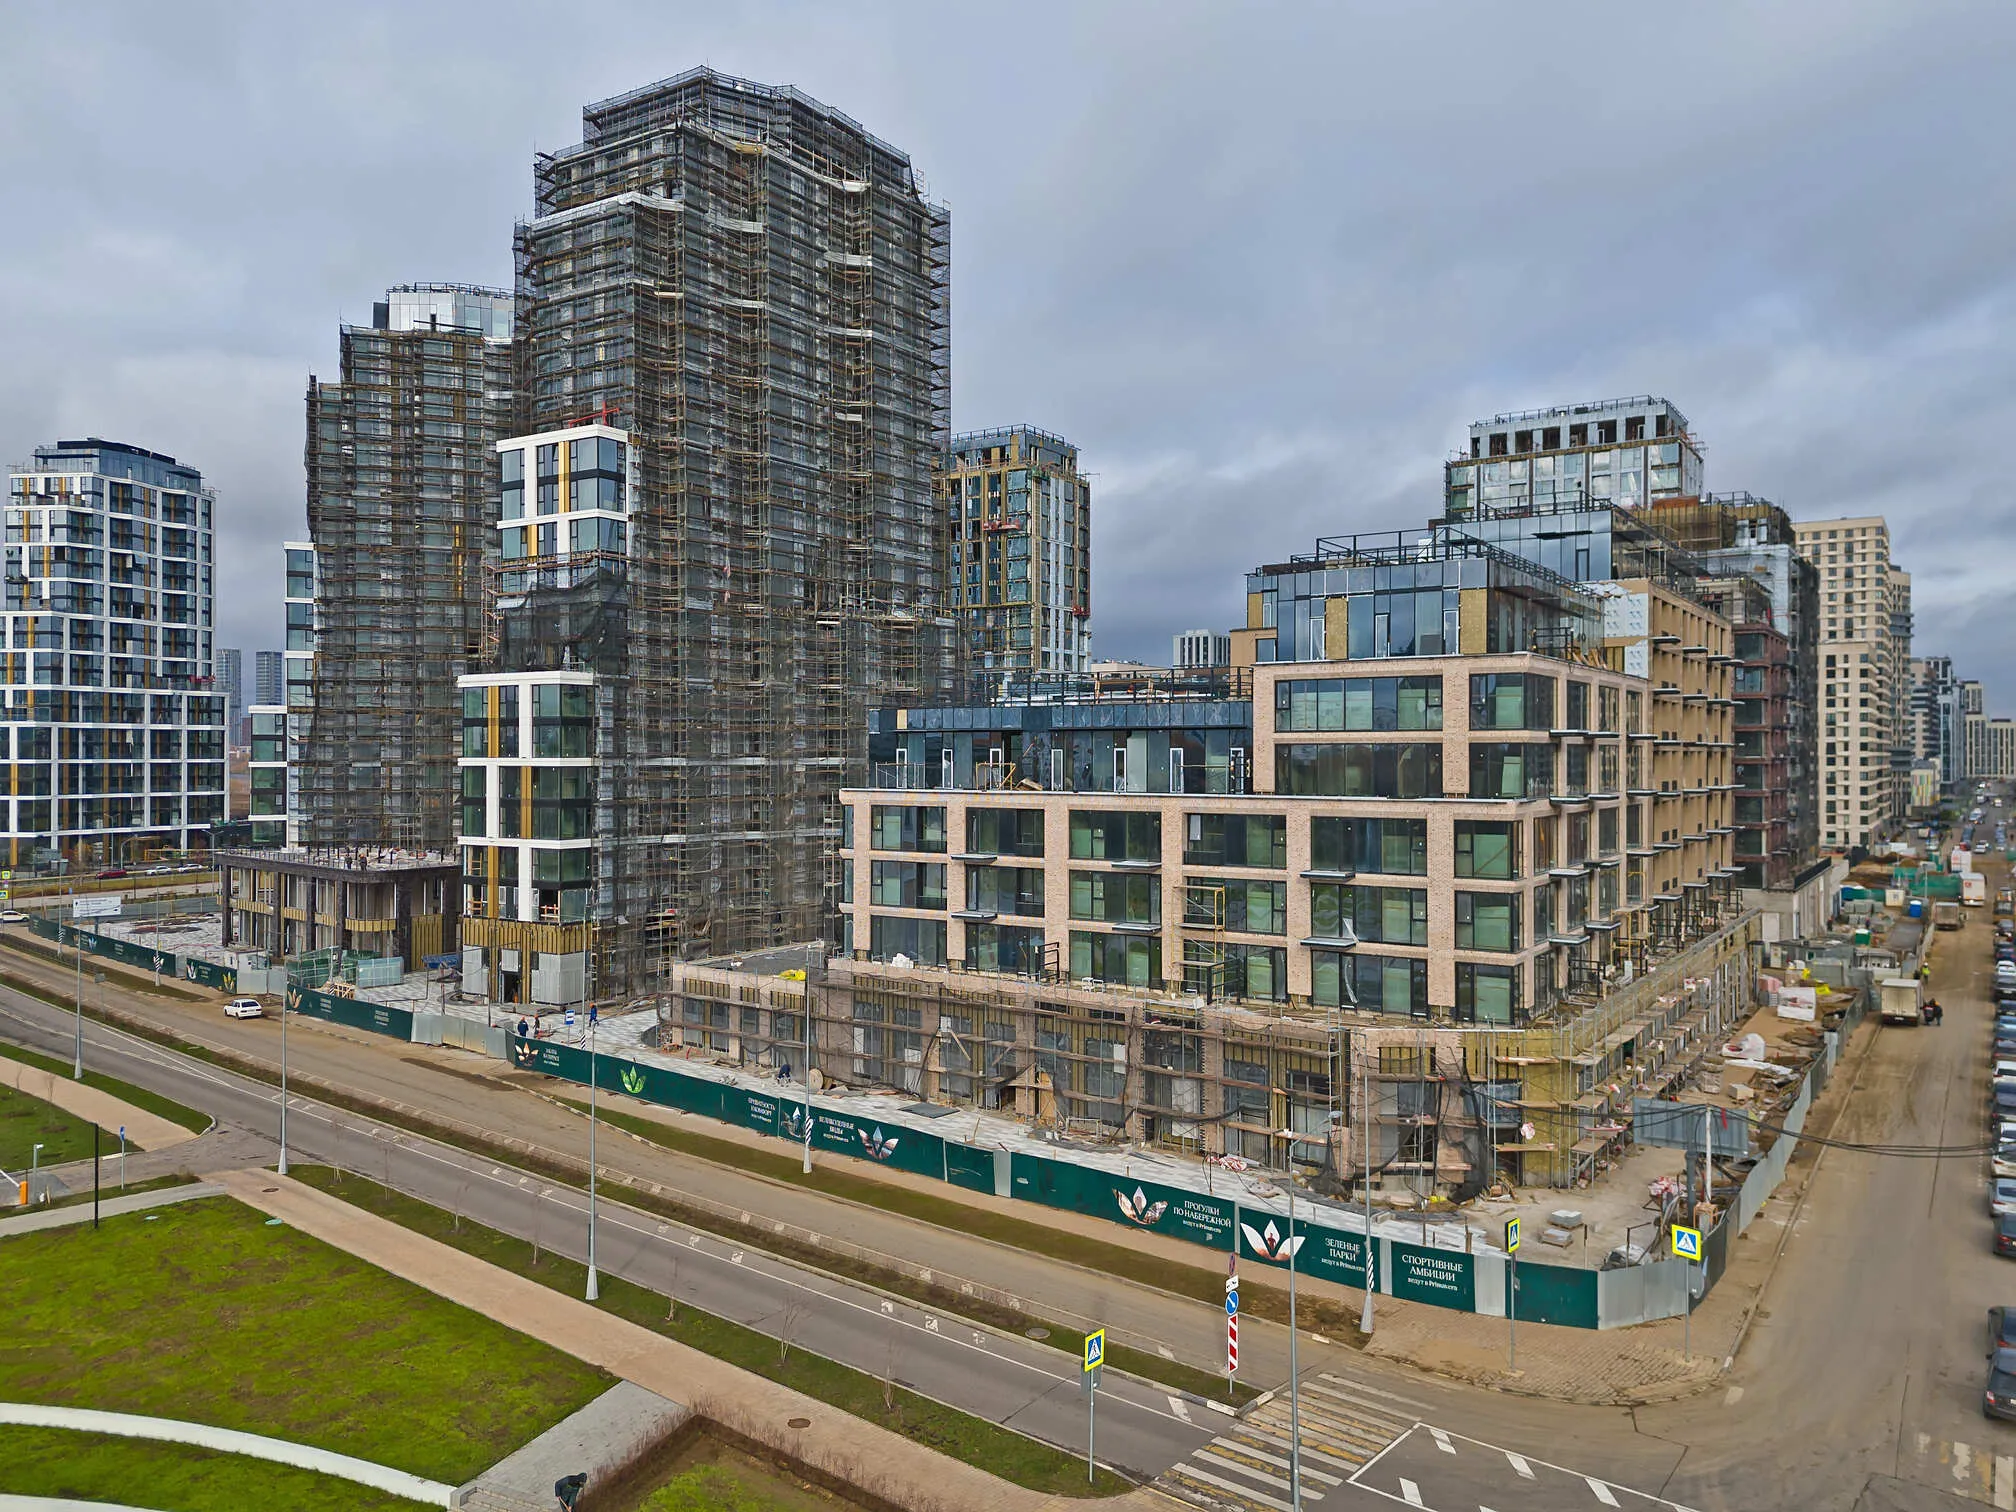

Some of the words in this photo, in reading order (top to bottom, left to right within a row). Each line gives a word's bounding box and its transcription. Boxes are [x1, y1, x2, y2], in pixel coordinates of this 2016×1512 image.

[1184, 1200, 1220, 1216] ПРОГУЛКИ
[1173, 1207, 1184, 1215] ПО
[1184, 1209, 1231, 1228] НАБЕРЕЖНОЙ
[1325, 1237, 1360, 1252] ЗЕЛЕНЫЕ
[1329, 1248, 1356, 1262] ПАРКИ
[1401, 1254, 1464, 1273] СПОРТИВНЫЕ
[1409, 1265, 1456, 1282] АМБИЦИИ
